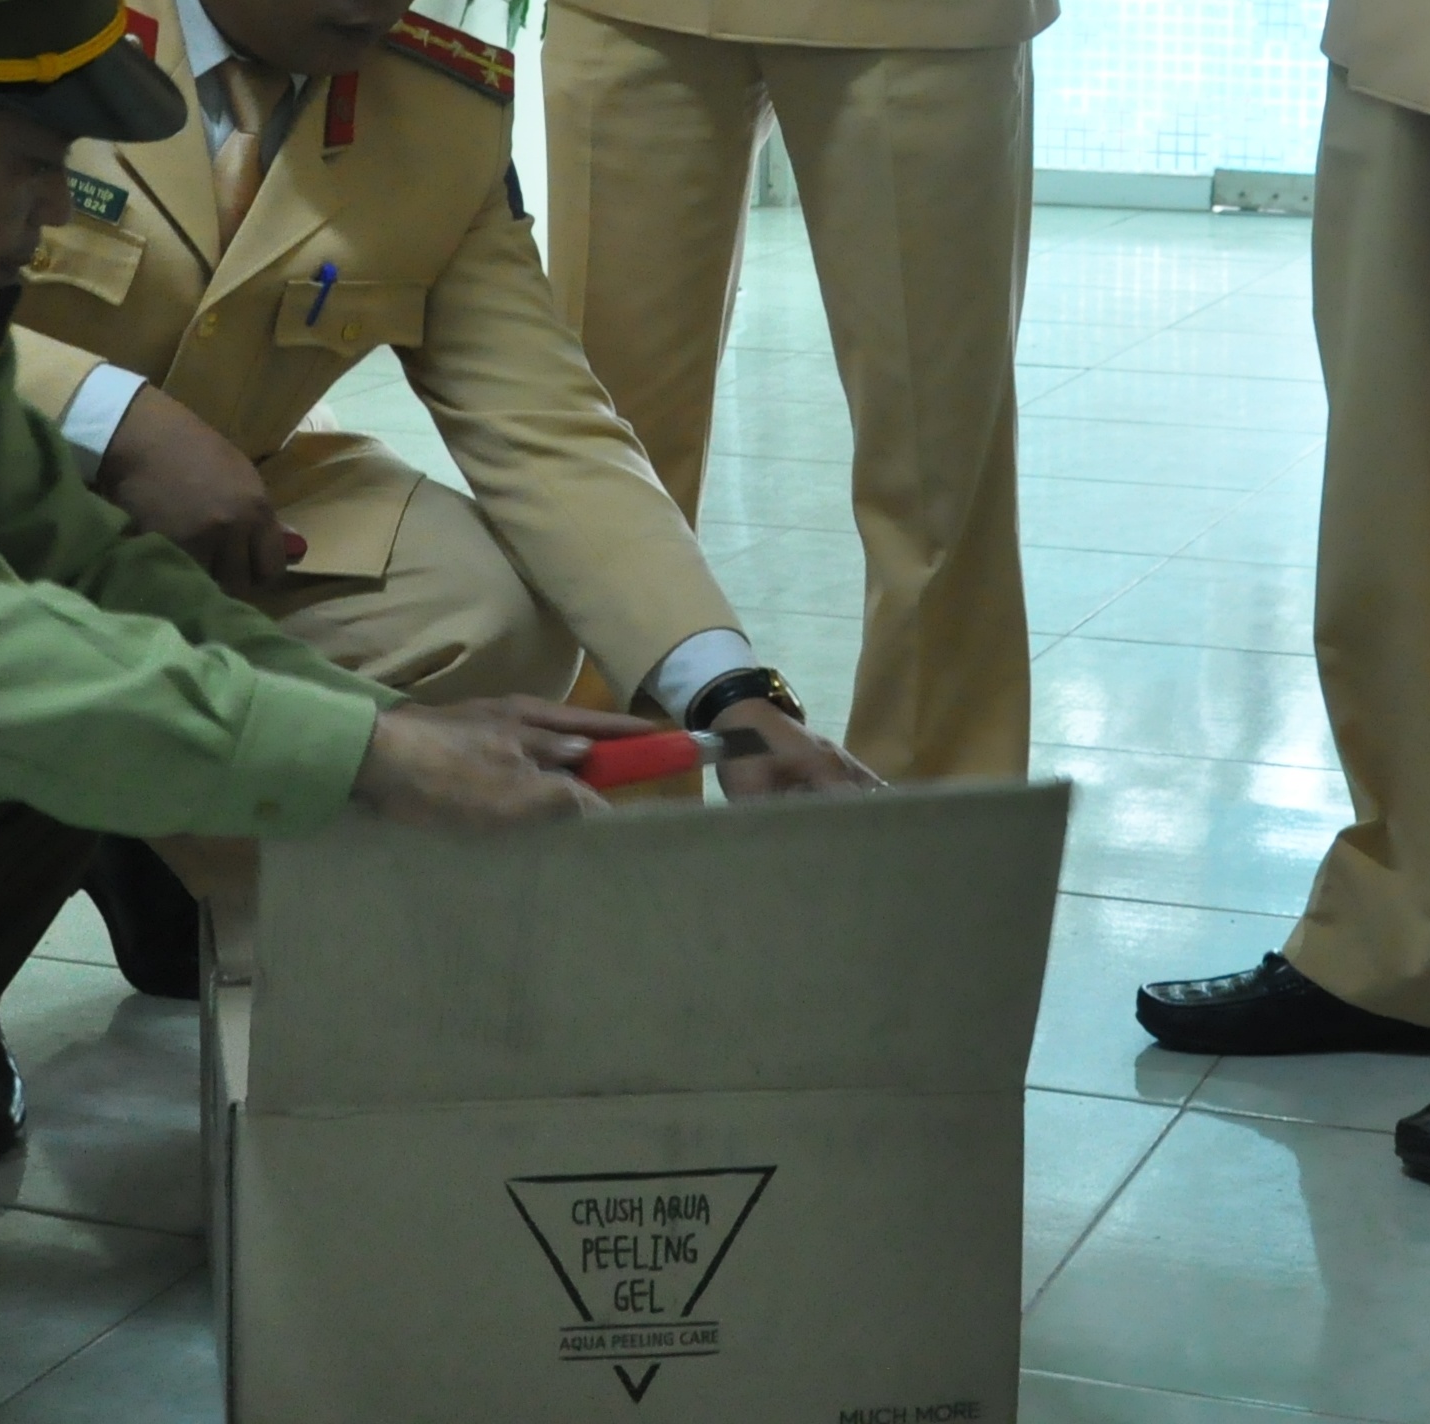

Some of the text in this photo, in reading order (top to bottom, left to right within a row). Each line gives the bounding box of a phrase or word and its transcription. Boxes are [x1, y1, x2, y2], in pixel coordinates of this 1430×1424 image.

[571, 1193, 710, 1228] CRUSH AQUA
[582, 1232, 698, 1273] PEELING
[614, 1278, 664, 1314] GEL
[559, 1329, 719, 1351] AQUA PEELING CARE
[839, 1401, 981, 1424] MUCH MORE
